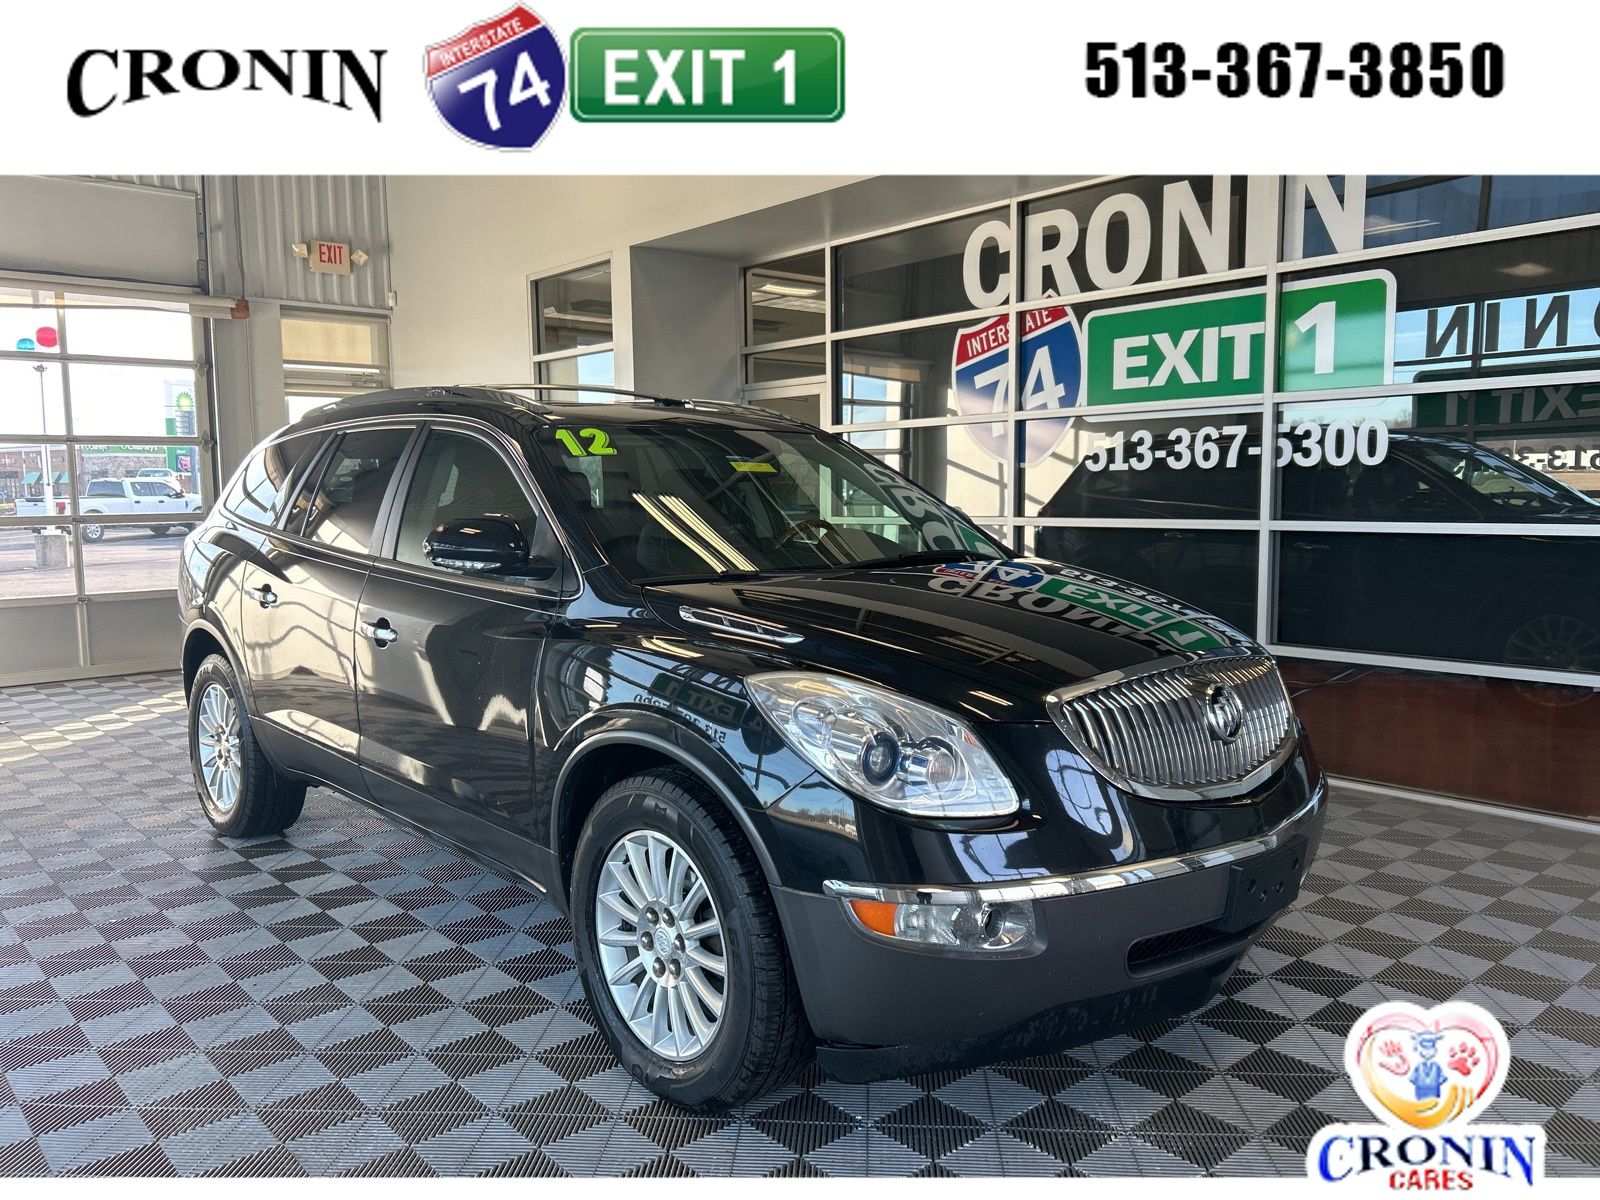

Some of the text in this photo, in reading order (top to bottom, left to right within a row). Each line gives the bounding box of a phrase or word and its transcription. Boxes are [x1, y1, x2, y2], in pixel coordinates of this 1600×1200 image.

[319, 243, 344, 265] EXIT
[963, 176, 1367, 309] CRONIN
[966, 309, 1052, 358] INTERATE
[1113, 301, 1336, 390] EXIT 1
[973, 345, 1066, 438] 74
[555, 428, 617, 457] 12
[1084, 418, 1389, 472] 513-367-5300
